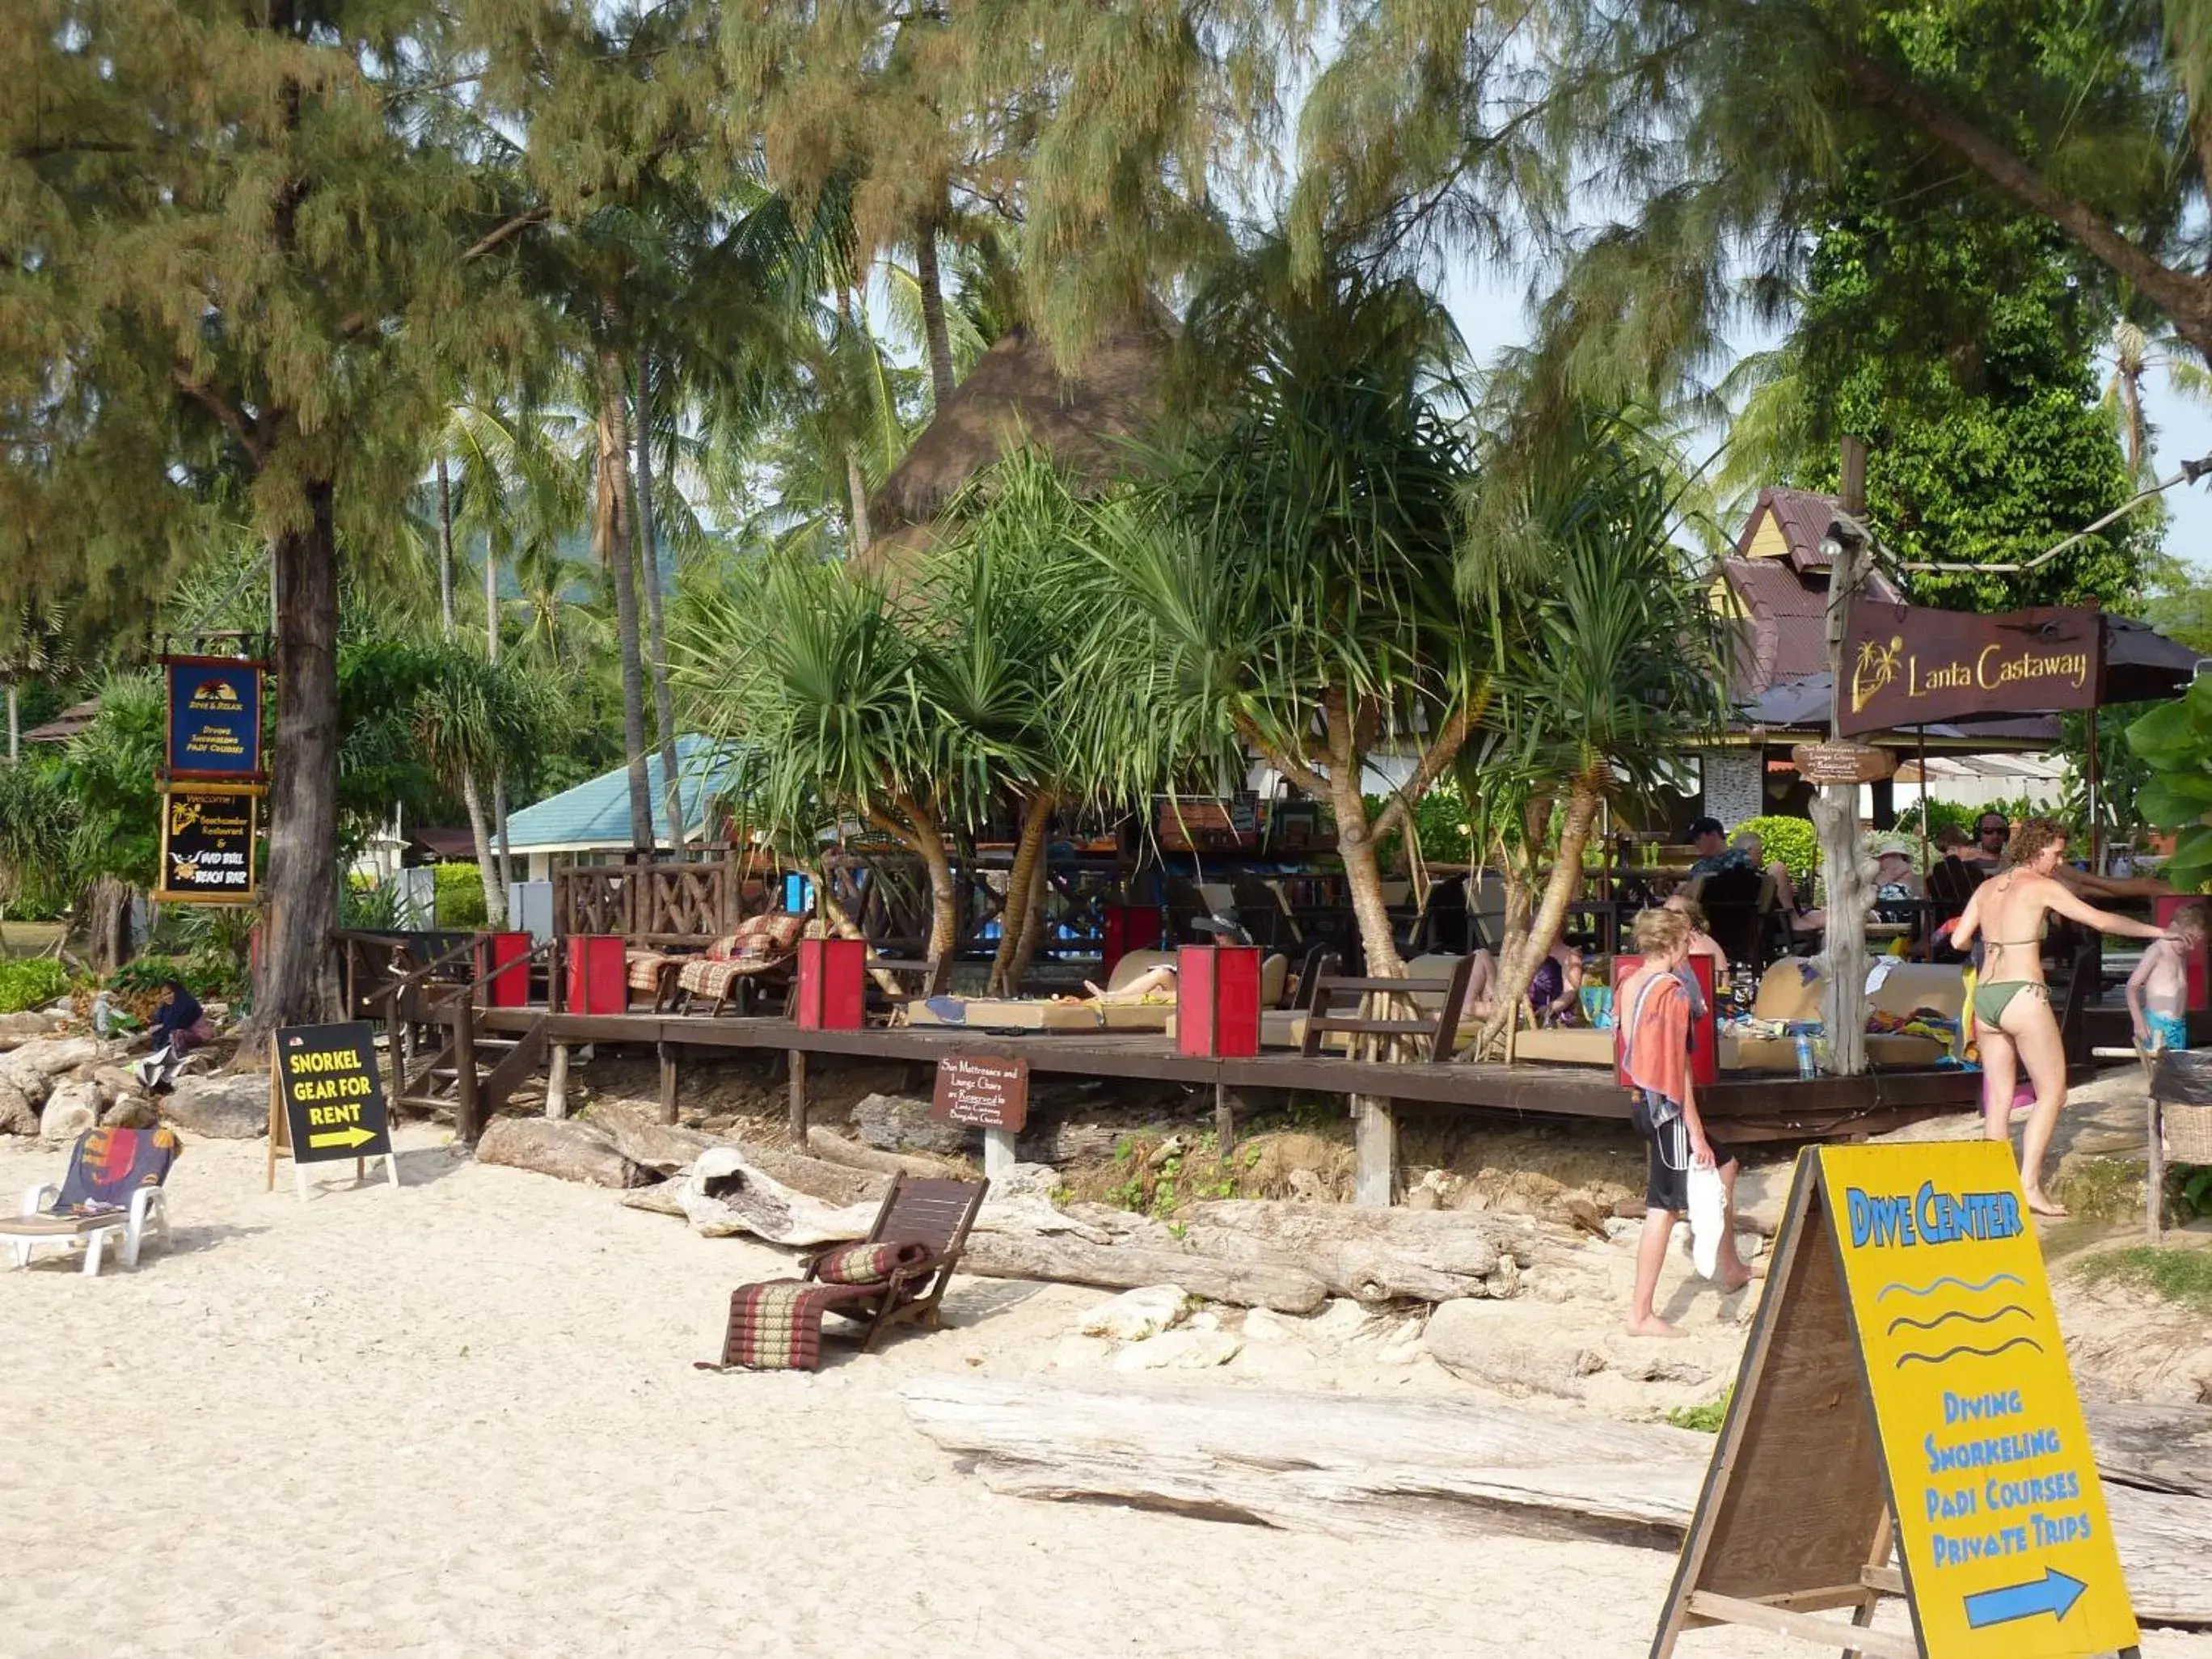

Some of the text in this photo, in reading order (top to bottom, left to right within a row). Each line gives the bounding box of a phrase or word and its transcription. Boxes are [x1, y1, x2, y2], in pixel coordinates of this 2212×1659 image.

[1909, 644, 2087, 697] Lanta Castaway
[195, 870, 247, 884] BEACH BAR
[289, 1049, 362, 1074] SNORKEL
[941, 1057, 957, 1071] Sun
[1003, 1068, 1018, 1079] and
[293, 1076, 372, 1101] GEAR FOR
[977, 1076, 1002, 1091] Chairs
[958, 1089, 998, 1104] Reserved
[309, 1104, 361, 1126] RENT
[1846, 1180, 2024, 1249] DIVE CENTER
[1943, 1389, 2024, 1425] DIVING
[1923, 1428, 2061, 1474] SNORKELING
[1925, 1471, 2080, 1523] PADI COURSES
[1932, 1511, 2092, 1568] PRIVATE TRIPS
